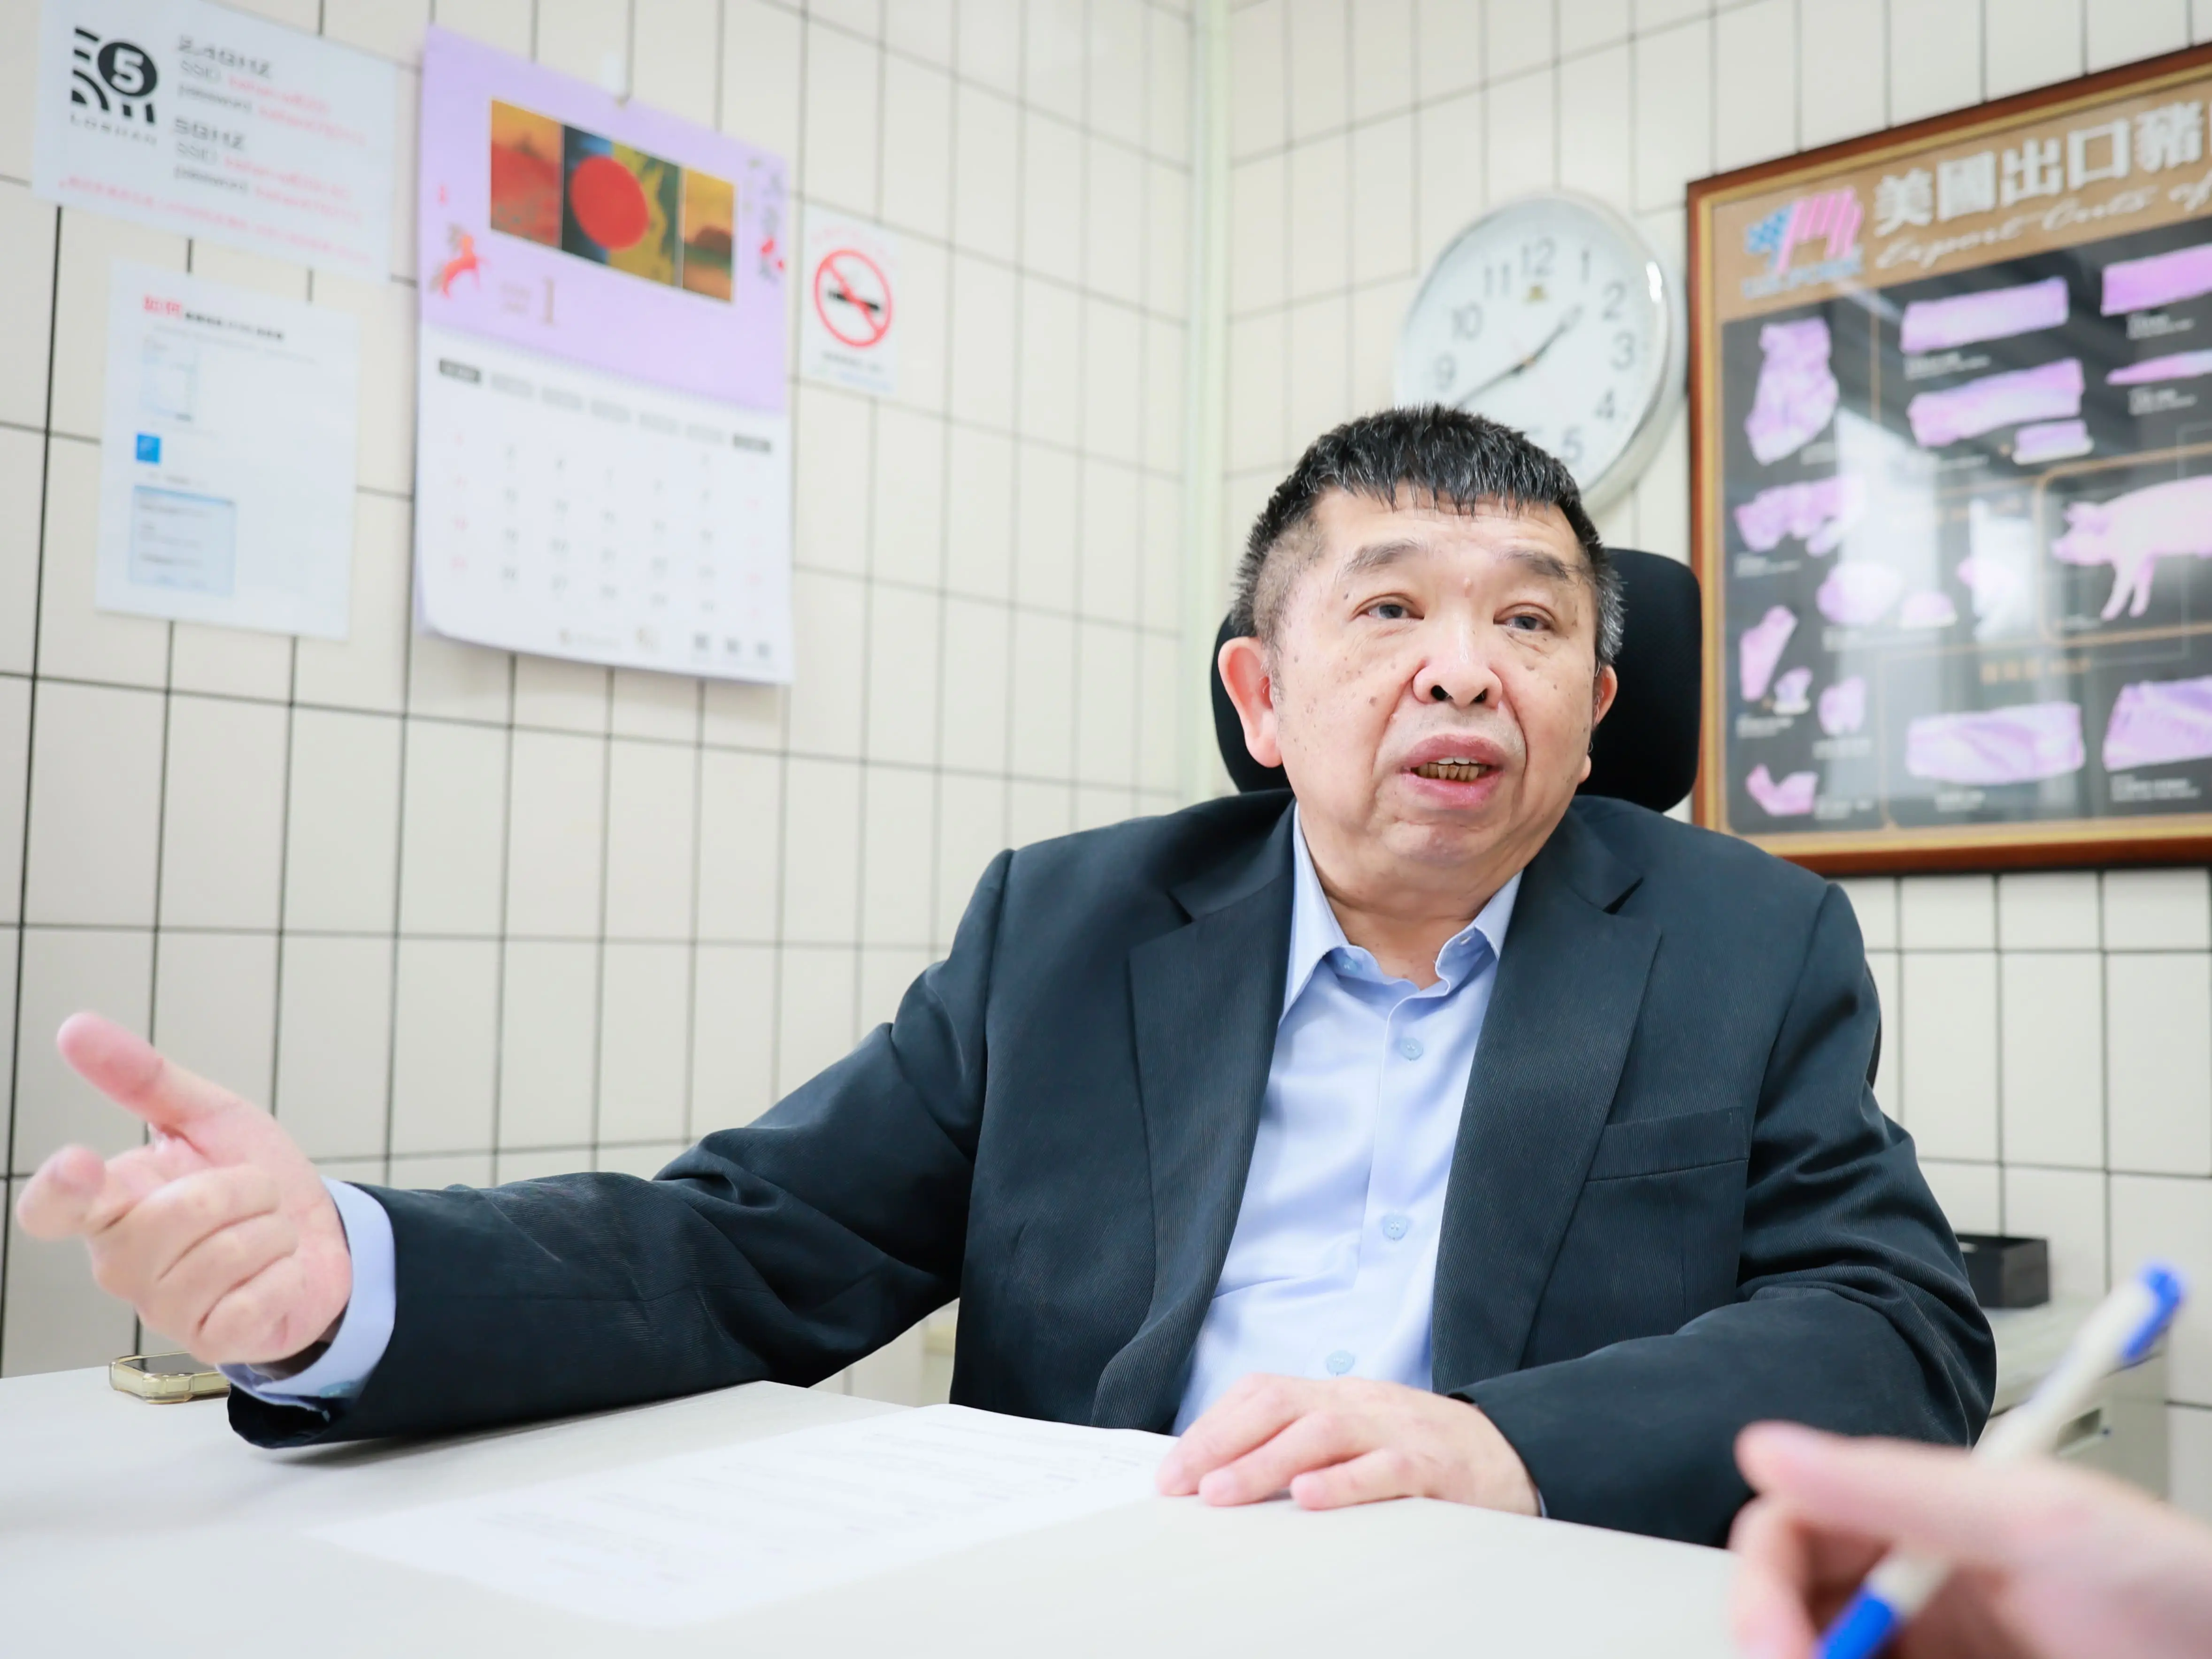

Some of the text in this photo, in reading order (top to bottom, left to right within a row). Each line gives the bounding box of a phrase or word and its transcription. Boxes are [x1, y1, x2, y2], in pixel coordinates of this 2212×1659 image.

[111, 46, 145, 93] 5
[1874, 100, 2212, 238] 美國出口豬
[1521, 237, 1557, 277] 12
[1580, 248, 1591, 284] 1
[1484, 263, 1512, 298] 11
[1452, 301, 1483, 341] 10
[1601, 281, 1627, 322] 2
[1610, 330, 1636, 371] 3
[1434, 354, 1455, 392] 9
[1593, 387, 1615, 421] 4
[1561, 426, 1584, 464] 5
